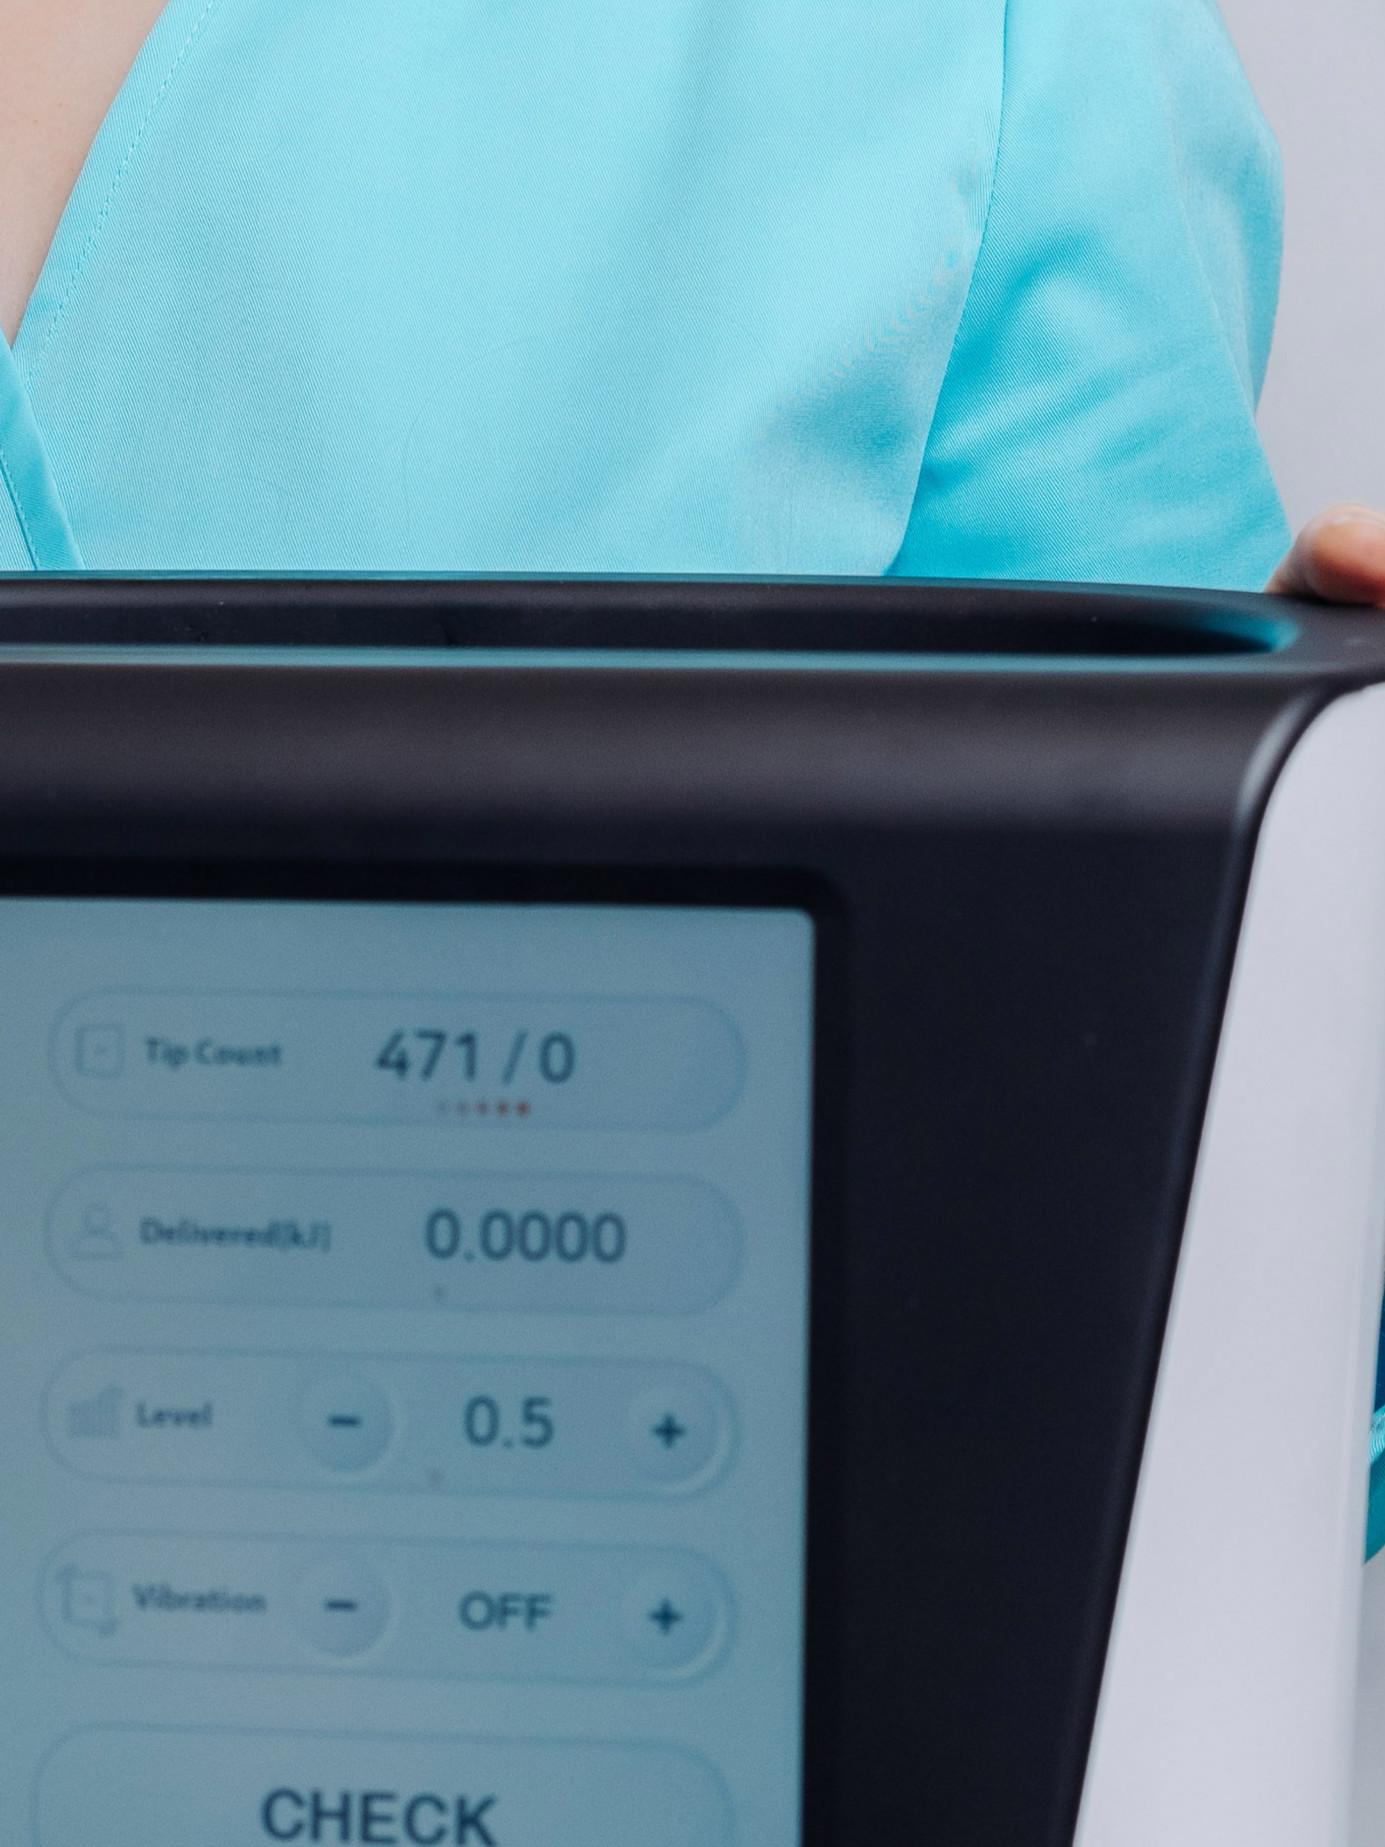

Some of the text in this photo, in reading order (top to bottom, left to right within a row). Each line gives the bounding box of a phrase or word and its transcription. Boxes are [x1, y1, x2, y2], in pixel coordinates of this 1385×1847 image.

[143, 1035, 283, 1072] Tip Count
[423, 1207, 627, 1264] 0.0000
[135, 1402, 213, 1429] Level
[463, 1394, 555, 1450] 0.5
[131, 1582, 268, 1614] Vibration
[458, 1590, 553, 1631] OFF
[260, 1787, 498, 1847] CHECK
